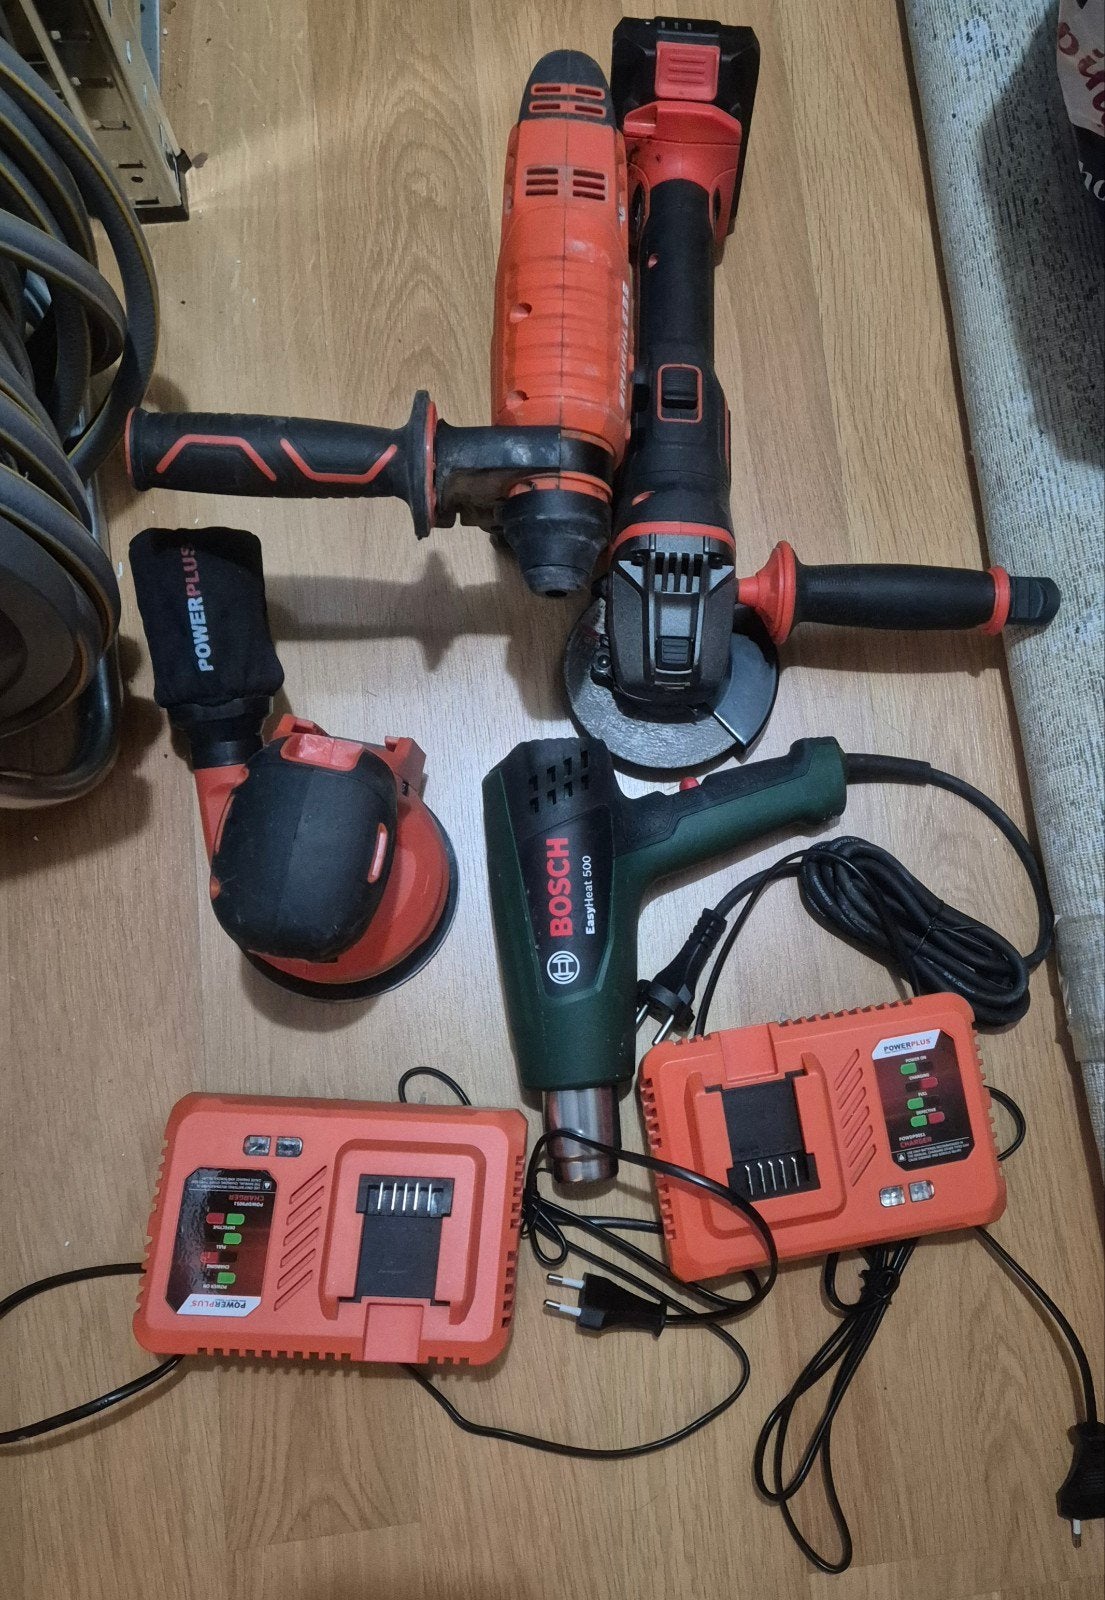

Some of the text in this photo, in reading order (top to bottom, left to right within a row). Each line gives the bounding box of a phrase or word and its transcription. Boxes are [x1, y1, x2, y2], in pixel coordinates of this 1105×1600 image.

[181, 547, 214, 671] POWERPLUS
[545, 837, 573, 937] BOSCH
[582, 855, 597, 934] EasyHeat 500
[883, 1038, 931, 1052] POWERPLUS
[900, 1136, 932, 1148] CHARGER
[228, 1194, 264, 1202] CHARGER
[191, 1300, 247, 1309] POWERPLUS
